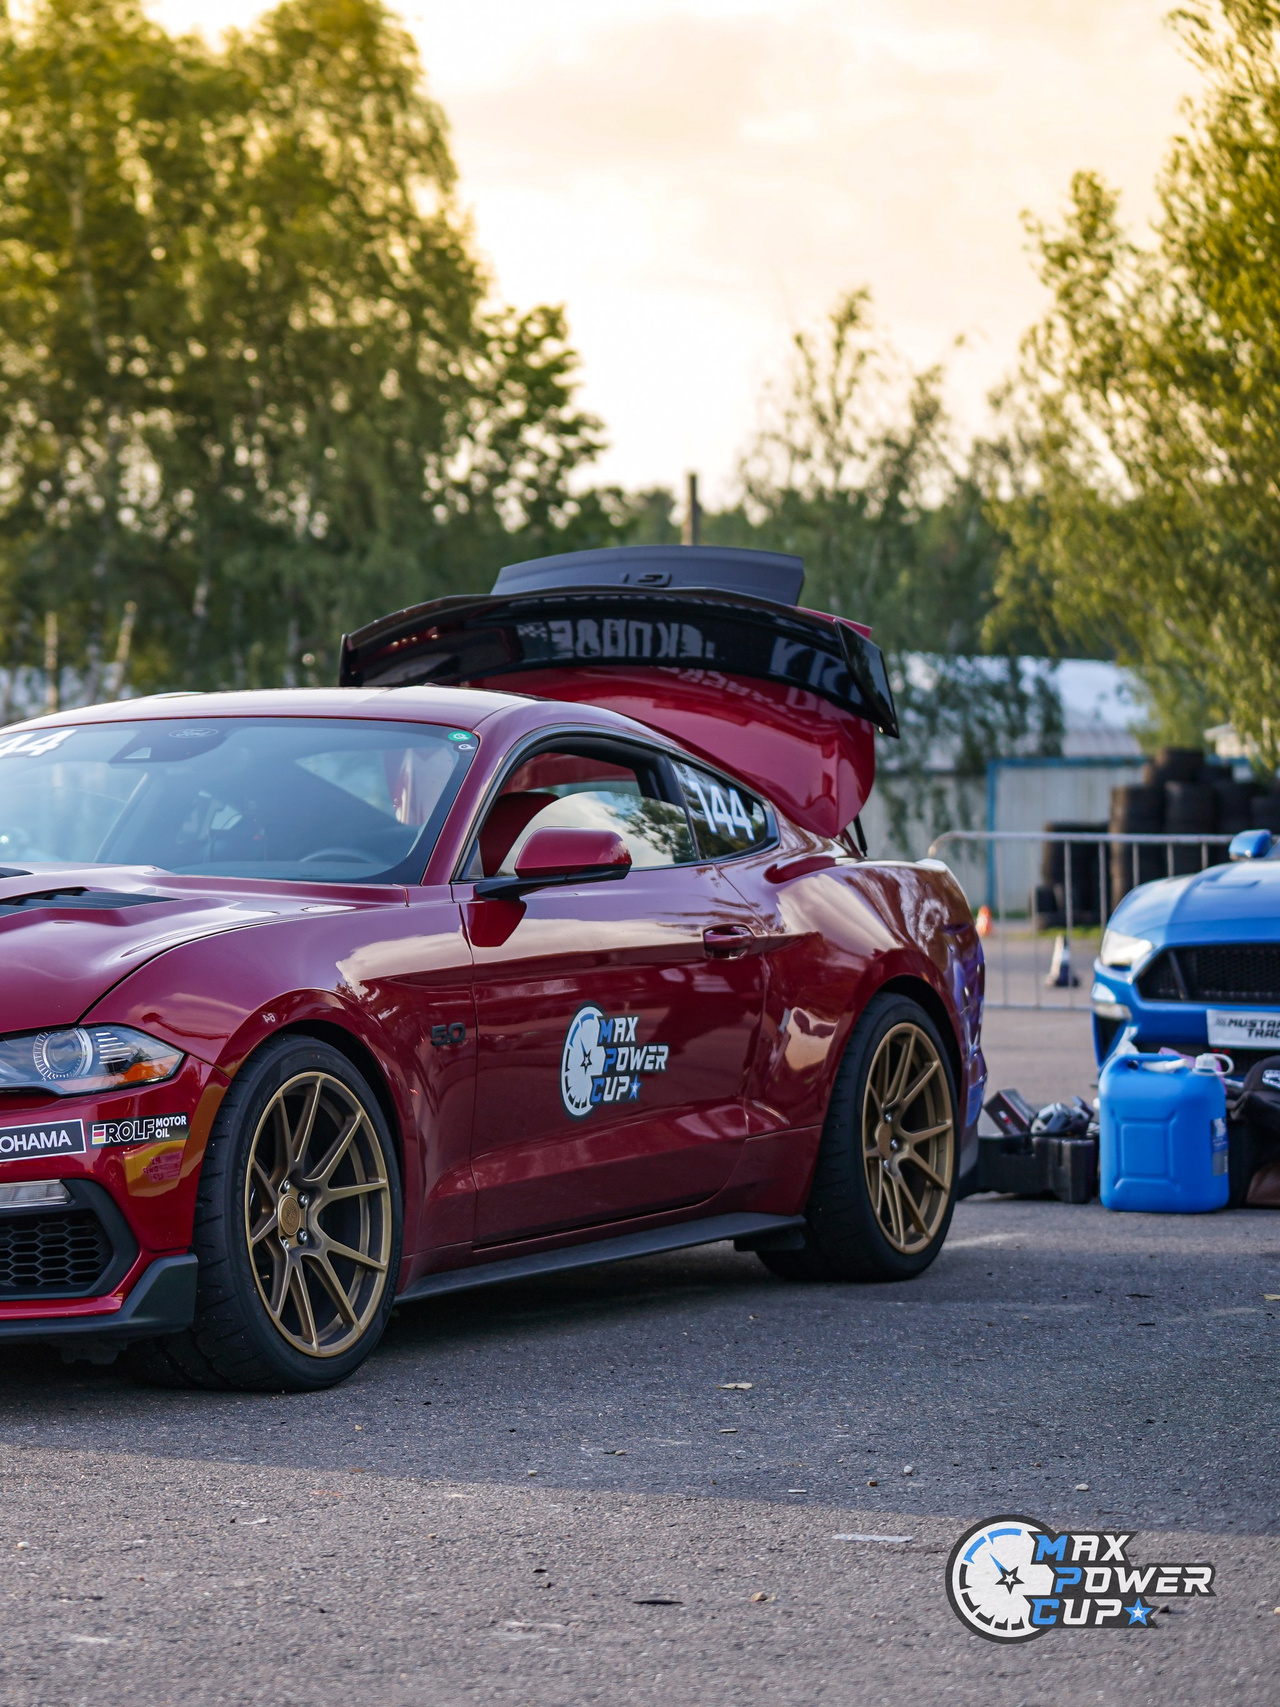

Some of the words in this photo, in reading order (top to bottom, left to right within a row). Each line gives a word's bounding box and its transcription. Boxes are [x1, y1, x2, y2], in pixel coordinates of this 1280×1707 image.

[688, 780, 755, 841] 144
[599, 1016, 639, 1044] MAX
[604, 1045, 669, 1072] POWER
[591, 1076, 631, 1102] CUP
[104, 1119, 155, 1143] ROLF
[155, 1115, 187, 1128] MOTOR
[155, 1128, 170, 1138] OIL
[383, 1244, 401, 1310] YOKOHAMA
